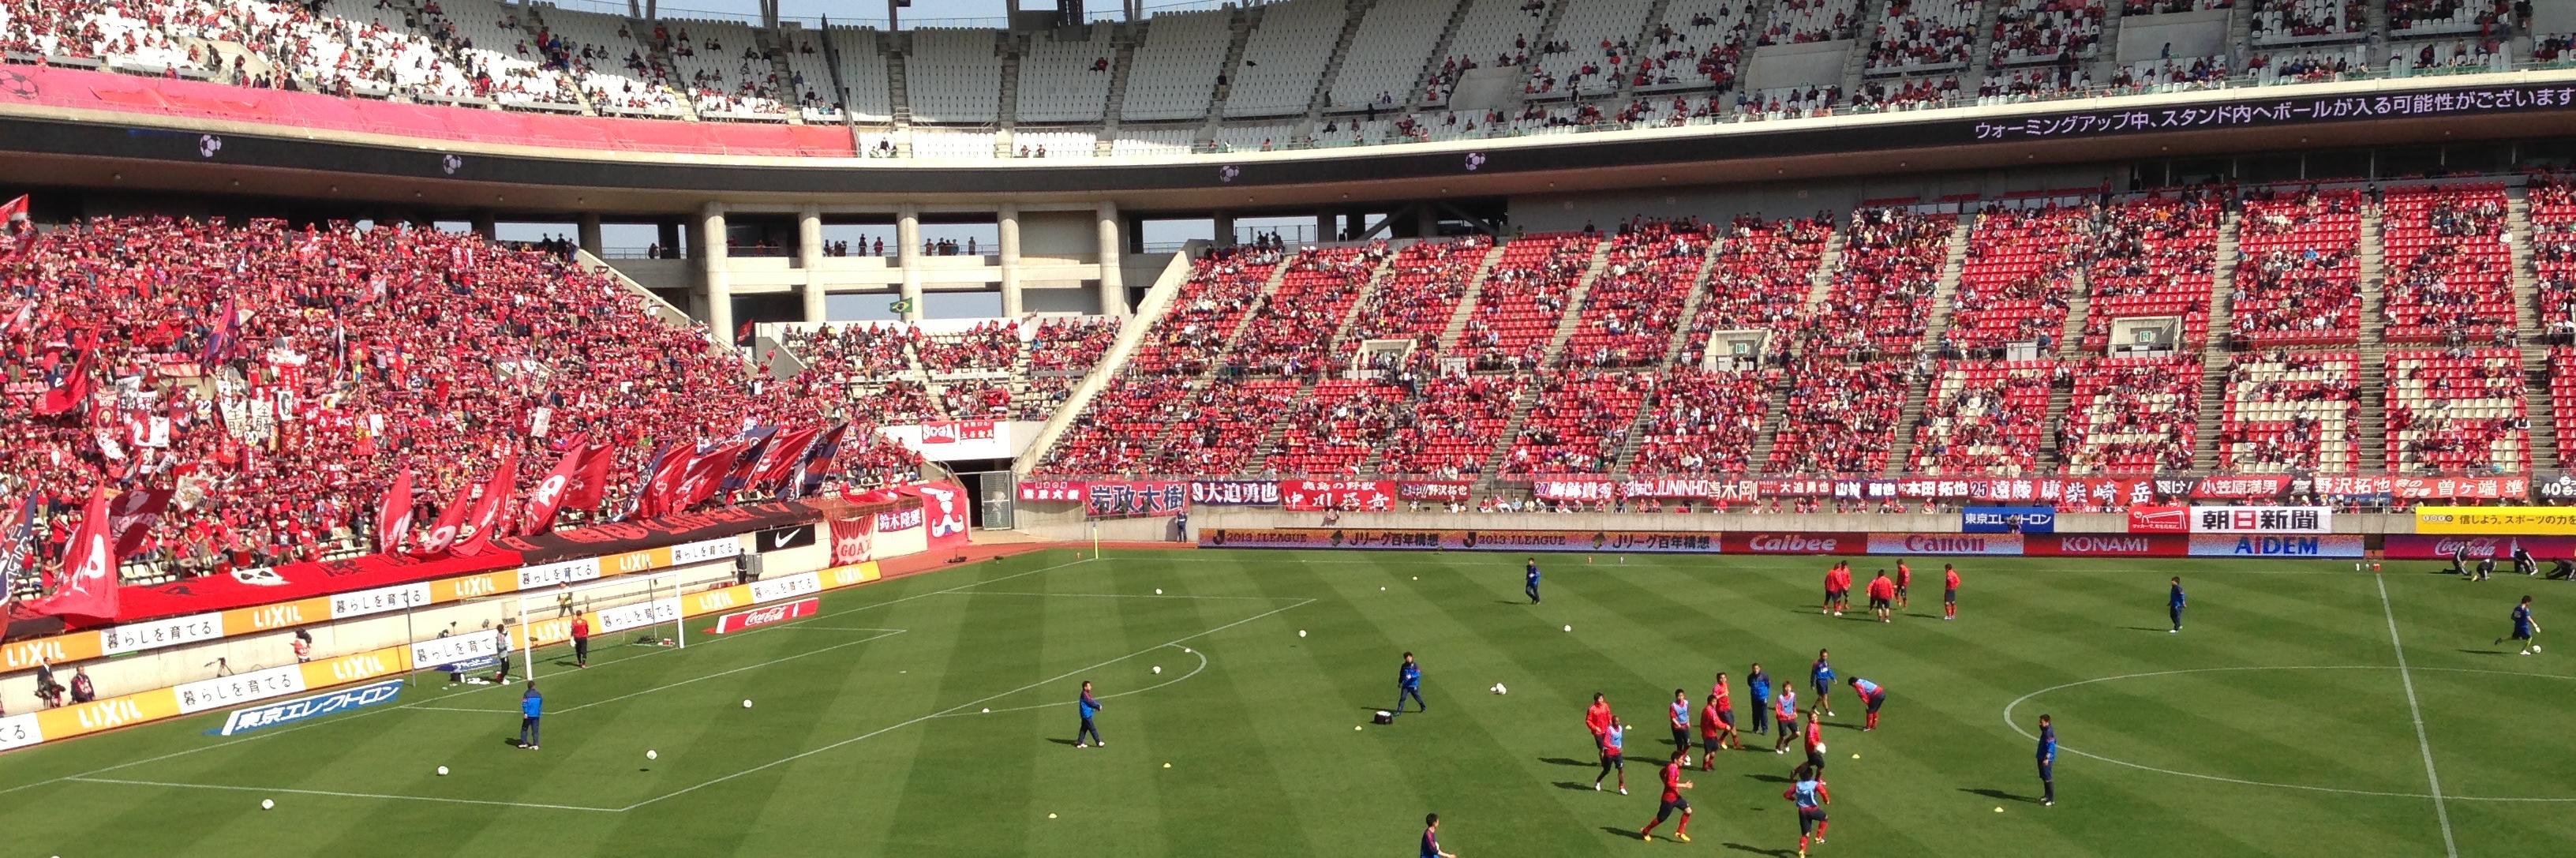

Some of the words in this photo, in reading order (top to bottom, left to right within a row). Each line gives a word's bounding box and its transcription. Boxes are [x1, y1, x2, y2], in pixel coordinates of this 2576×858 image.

[2200, 479, 2278, 496] 小笠原満男
[2315, 477, 2391, 495] 野沢拓也
[1091, 484, 1186, 512] 岩政大樹
[1965, 514, 2051, 525] 東京エレトロン
[2202, 510, 2319, 530] 朝日新聞
[1612, 534, 1710, 549] Jリーグ百年構想
[1749, 534, 1837, 551] Calbee
[1904, 535, 1986, 553] Canon
[2061, 537, 2149, 553] KONAMI
[455, 576, 496, 596] LIXIL
[253, 605, 303, 628] LIXIL
[107, 621, 213, 650] 暮らしを育てる
[6, 640, 67, 667] LIXIL
[331, 655, 385, 680] LIXIL
[183, 673, 292, 706] 暮らしを育てる
[79, 699, 143, 729] LIXIL
[235, 686, 400, 732] 東京エレクトロン
